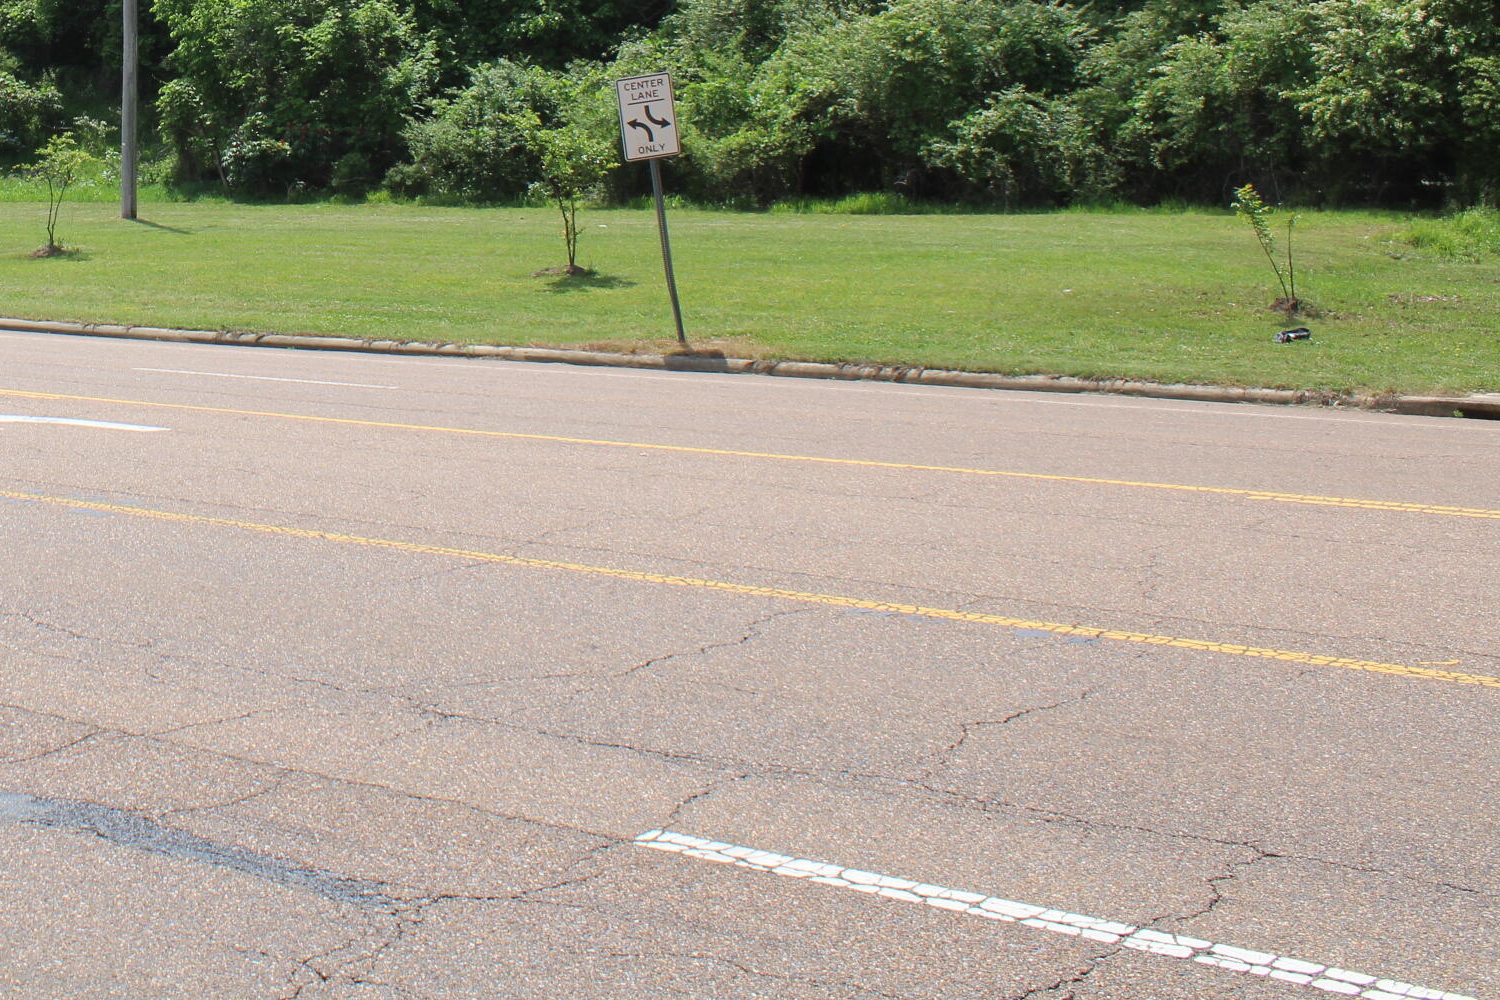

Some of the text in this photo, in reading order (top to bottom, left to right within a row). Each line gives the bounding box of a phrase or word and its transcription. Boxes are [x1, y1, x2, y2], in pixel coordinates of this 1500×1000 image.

[623, 78, 663, 91] CENTER
[631, 89, 659, 100] LANE
[638, 143, 665, 154] ONLY
